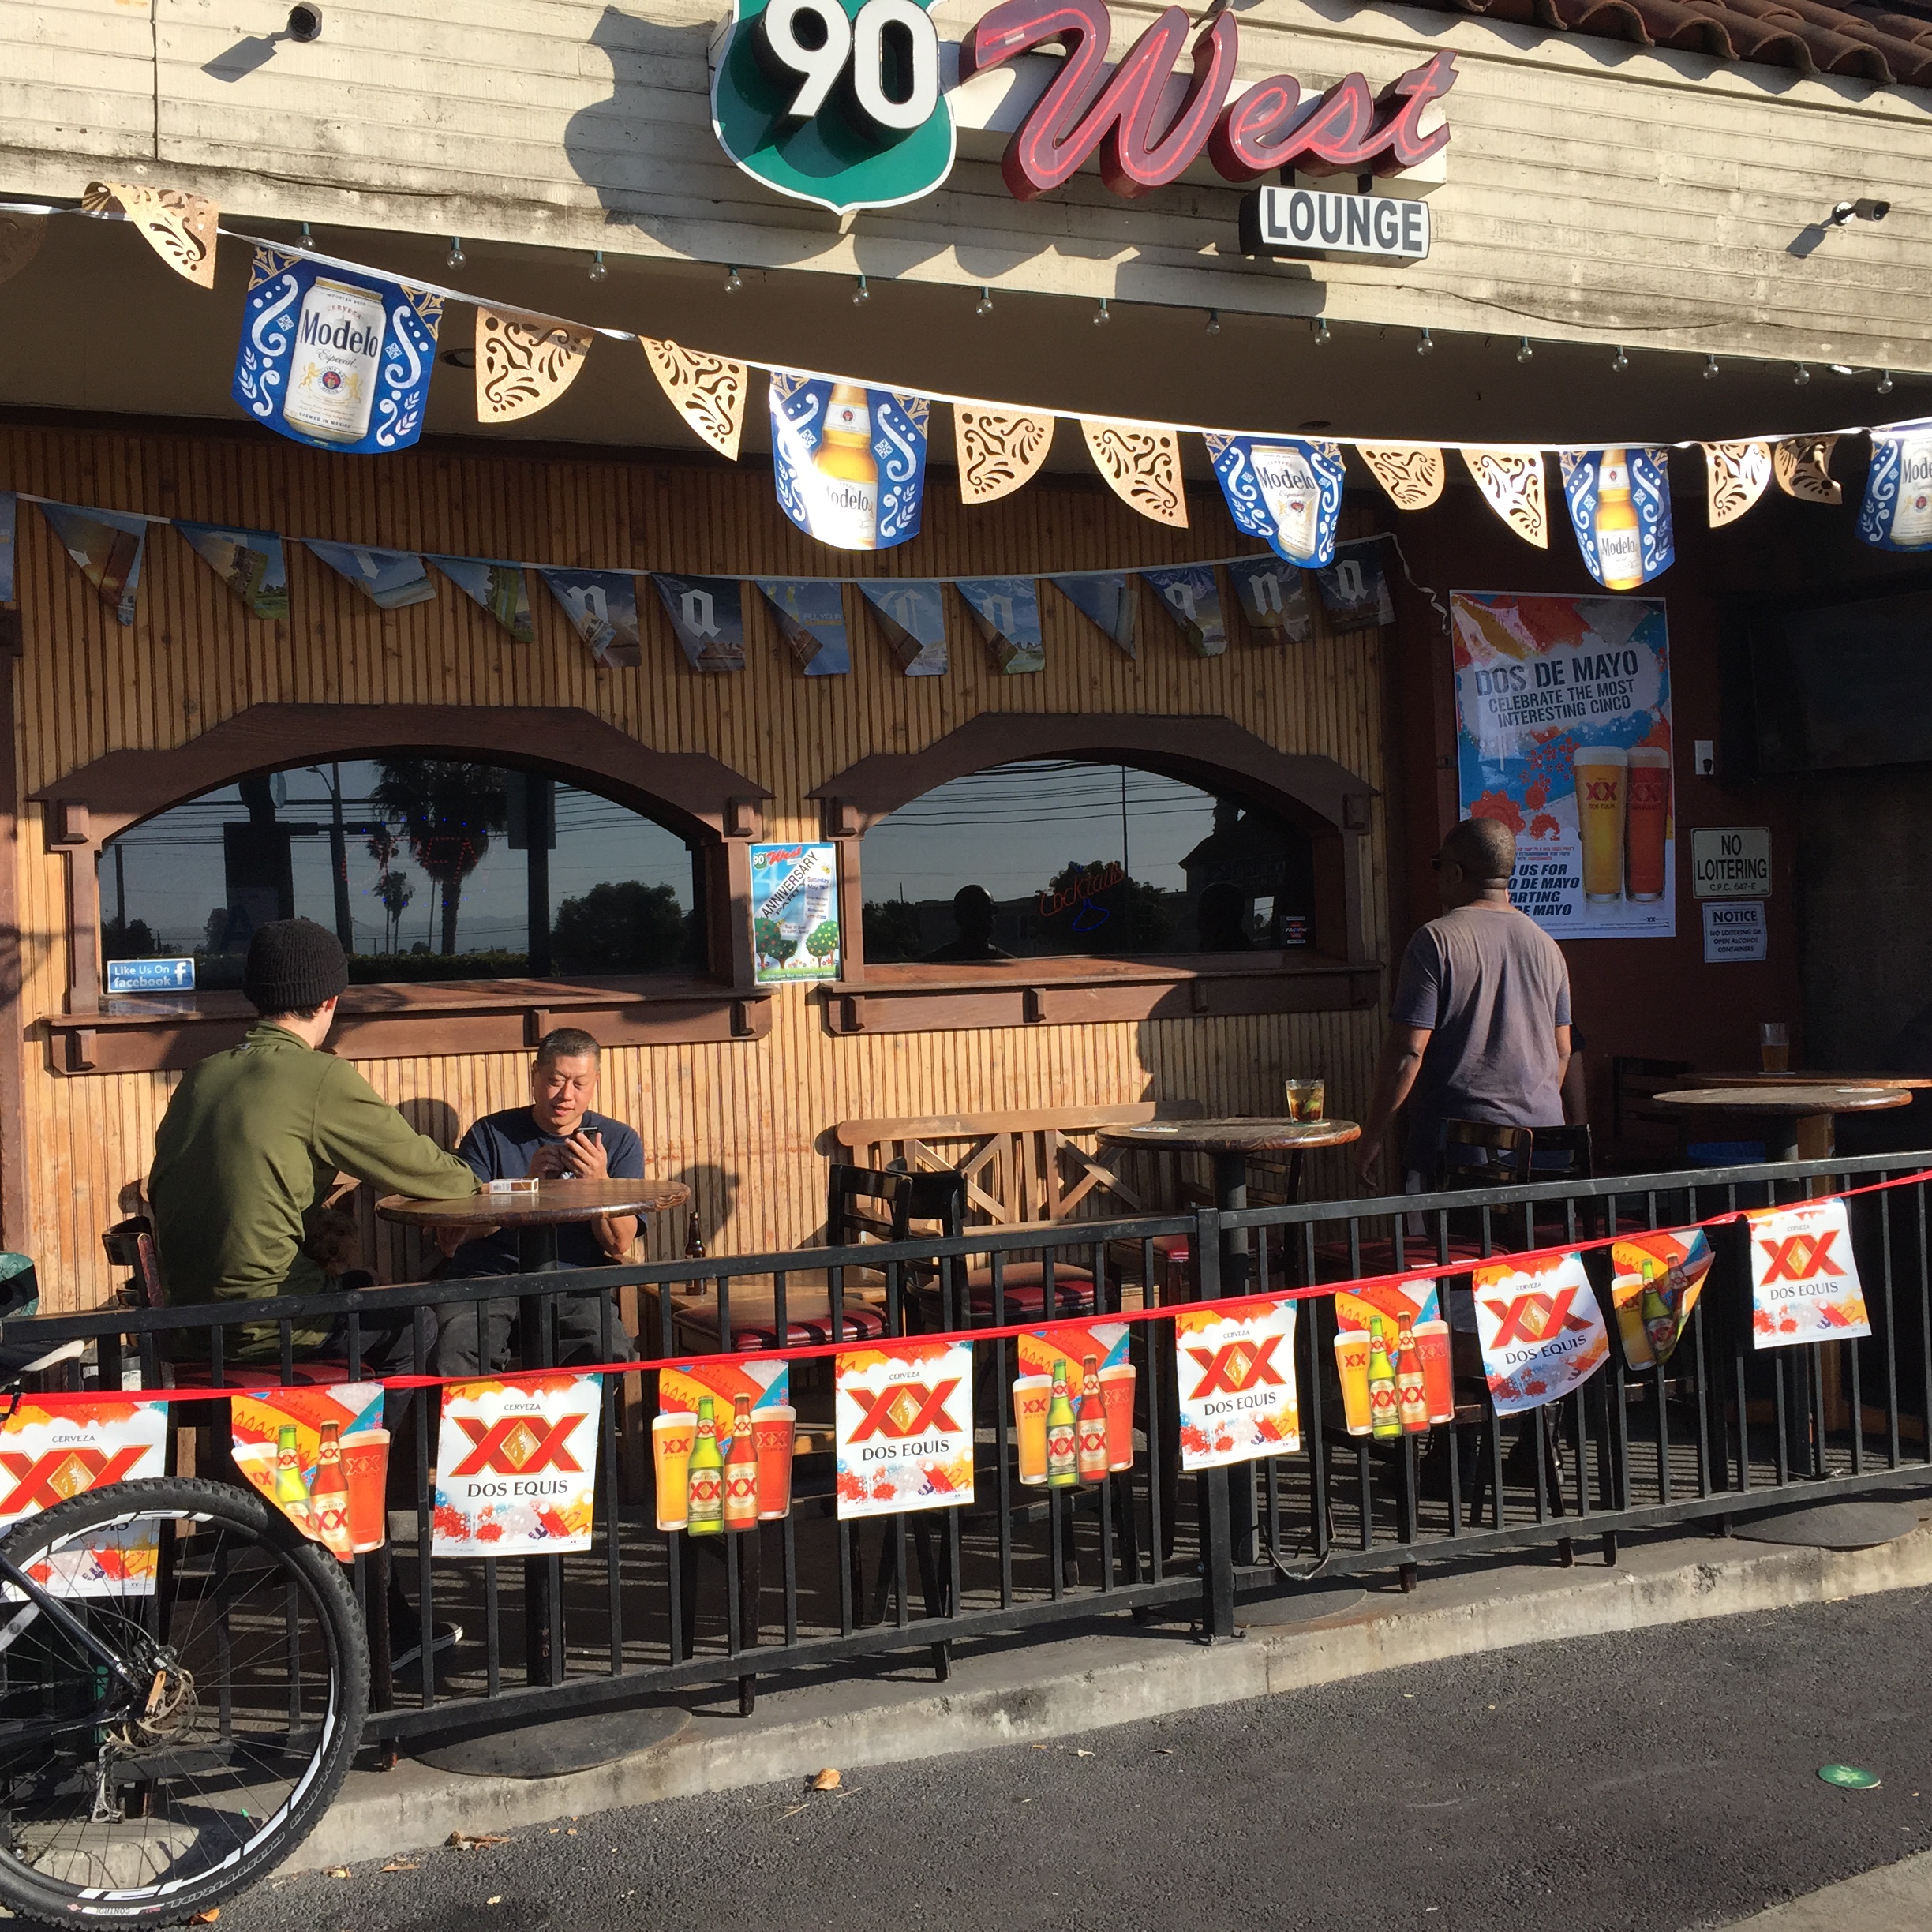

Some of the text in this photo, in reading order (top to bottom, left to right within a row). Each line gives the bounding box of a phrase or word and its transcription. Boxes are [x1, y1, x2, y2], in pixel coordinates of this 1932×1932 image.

[764, 0, 1458, 193] 90 West
[1267, 189, 1423, 252] LOUNGE
[300, 309, 379, 358] Modelo
[1256, 466, 1315, 489] Modelo
[1601, 537, 1634, 556] Modelo
[1475, 650, 1638, 696] DOS DE MAYO
[1488, 679, 1634, 713] CELEBRATE THE MOST
[1497, 695, 1631, 728] INTERESTING CINCO
[1721, 834, 1741, 856] NO
[753, 855, 765, 865] 90
[1519, 864, 1538, 876] US
[1541, 864, 1567, 876] FOR
[1697, 858, 1767, 881] LOITERING
[762, 850, 818, 919] ANNIVERSARY
[1520, 878, 1539, 889] DE
[1541, 877, 1580, 889] MAYO
[776, 878, 805, 915] PARTY
[1508, 891, 1561, 904] ARTING
[1533, 904, 1573, 916] MAYO
[1713, 910, 1757, 923] NOTICE
[114, 964, 169, 975] Like Us On
[174, 961, 186, 985] f
[114, 975, 170, 987] facebook
[1758, 1229, 1849, 1287] XX
[1515, 1282, 1542, 1291] CERVEZA
[1770, 1282, 1838, 1300] DOS EQUIS
[1481, 1285, 1595, 1350] XX
[1223, 1330, 1250, 1339] CERVEZA
[1505, 1335, 1586, 1365] DOS EQUIS
[1185, 1333, 1287, 1401] XX
[1344, 1353, 1366, 1368] XX
[889, 1372, 920, 1380] CERVEZA
[1204, 1392, 1276, 1416] DOS EQUIS
[1371, 1389, 1397, 1408] XX
[1399, 1386, 1426, 1404] XX
[845, 1377, 963, 1445] XX
[1023, 1398, 1046, 1414] XX
[448, 1413, 589, 1477] XX
[662, 1437, 690, 1455] XX
[863, 1440, 949, 1462] DOS EQUIS
[1048, 1437, 1076, 1457] XX
[1080, 1433, 1106, 1451] XX
[319, 1448, 339, 1459] XX
[250, 1471, 272, 1485] XX
[726, 1477, 758, 1498] XX
[467, 1480, 567, 1497] DOS EQUIS
[689, 1481, 722, 1501] XX
[313, 1508, 349, 1532] XX
[166, 1831, 286, 1908] CONTROL
